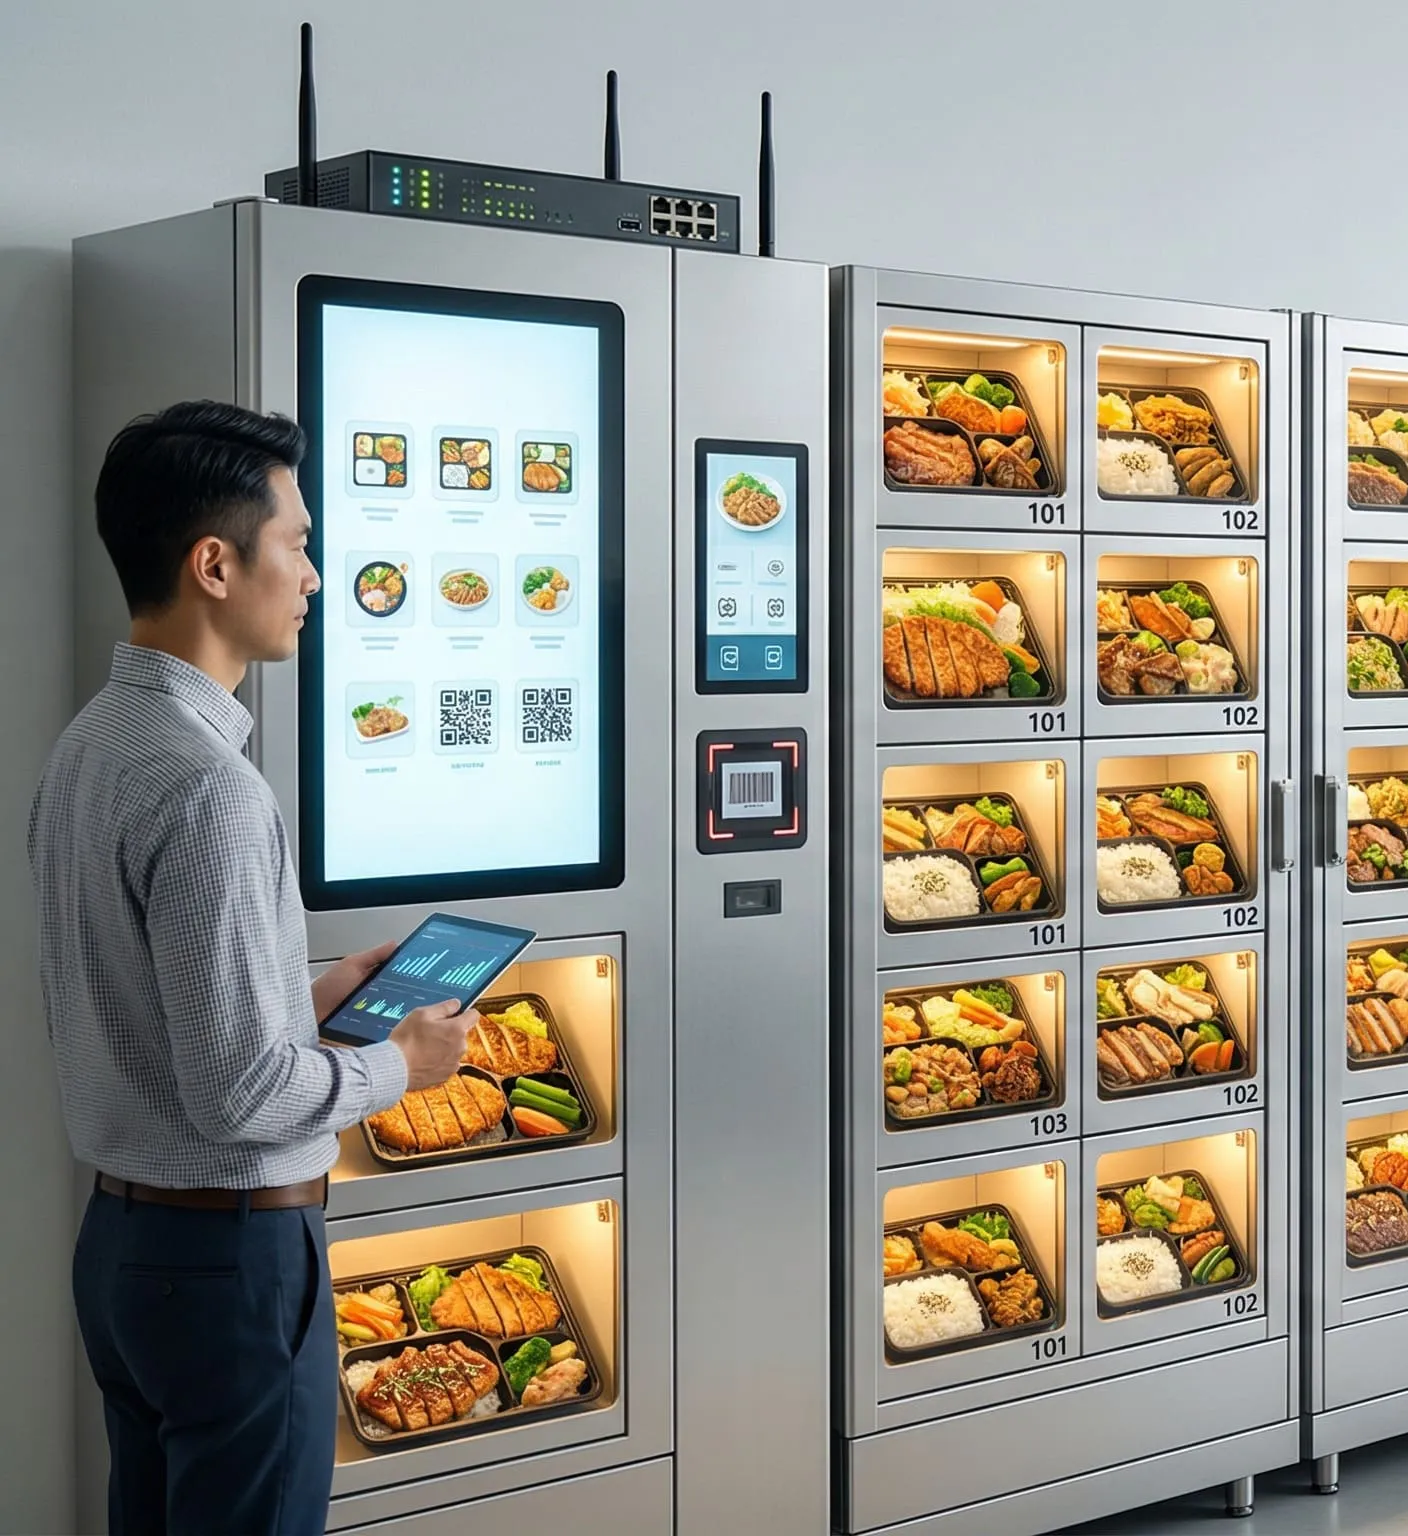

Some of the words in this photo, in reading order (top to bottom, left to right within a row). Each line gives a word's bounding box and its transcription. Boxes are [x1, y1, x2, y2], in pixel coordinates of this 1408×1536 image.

[1029, 503, 1065, 525] 101
[1223, 511, 1259, 530] 102
[1029, 712, 1065, 733] 101
[1223, 707, 1258, 726] 102
[1223, 907, 1258, 928] 102
[1030, 924, 1065, 946] 101
[1224, 1084, 1259, 1106] 102
[1031, 1113, 1068, 1136] 103
[1224, 1293, 1258, 1317] 102
[1032, 1336, 1066, 1361] 101
